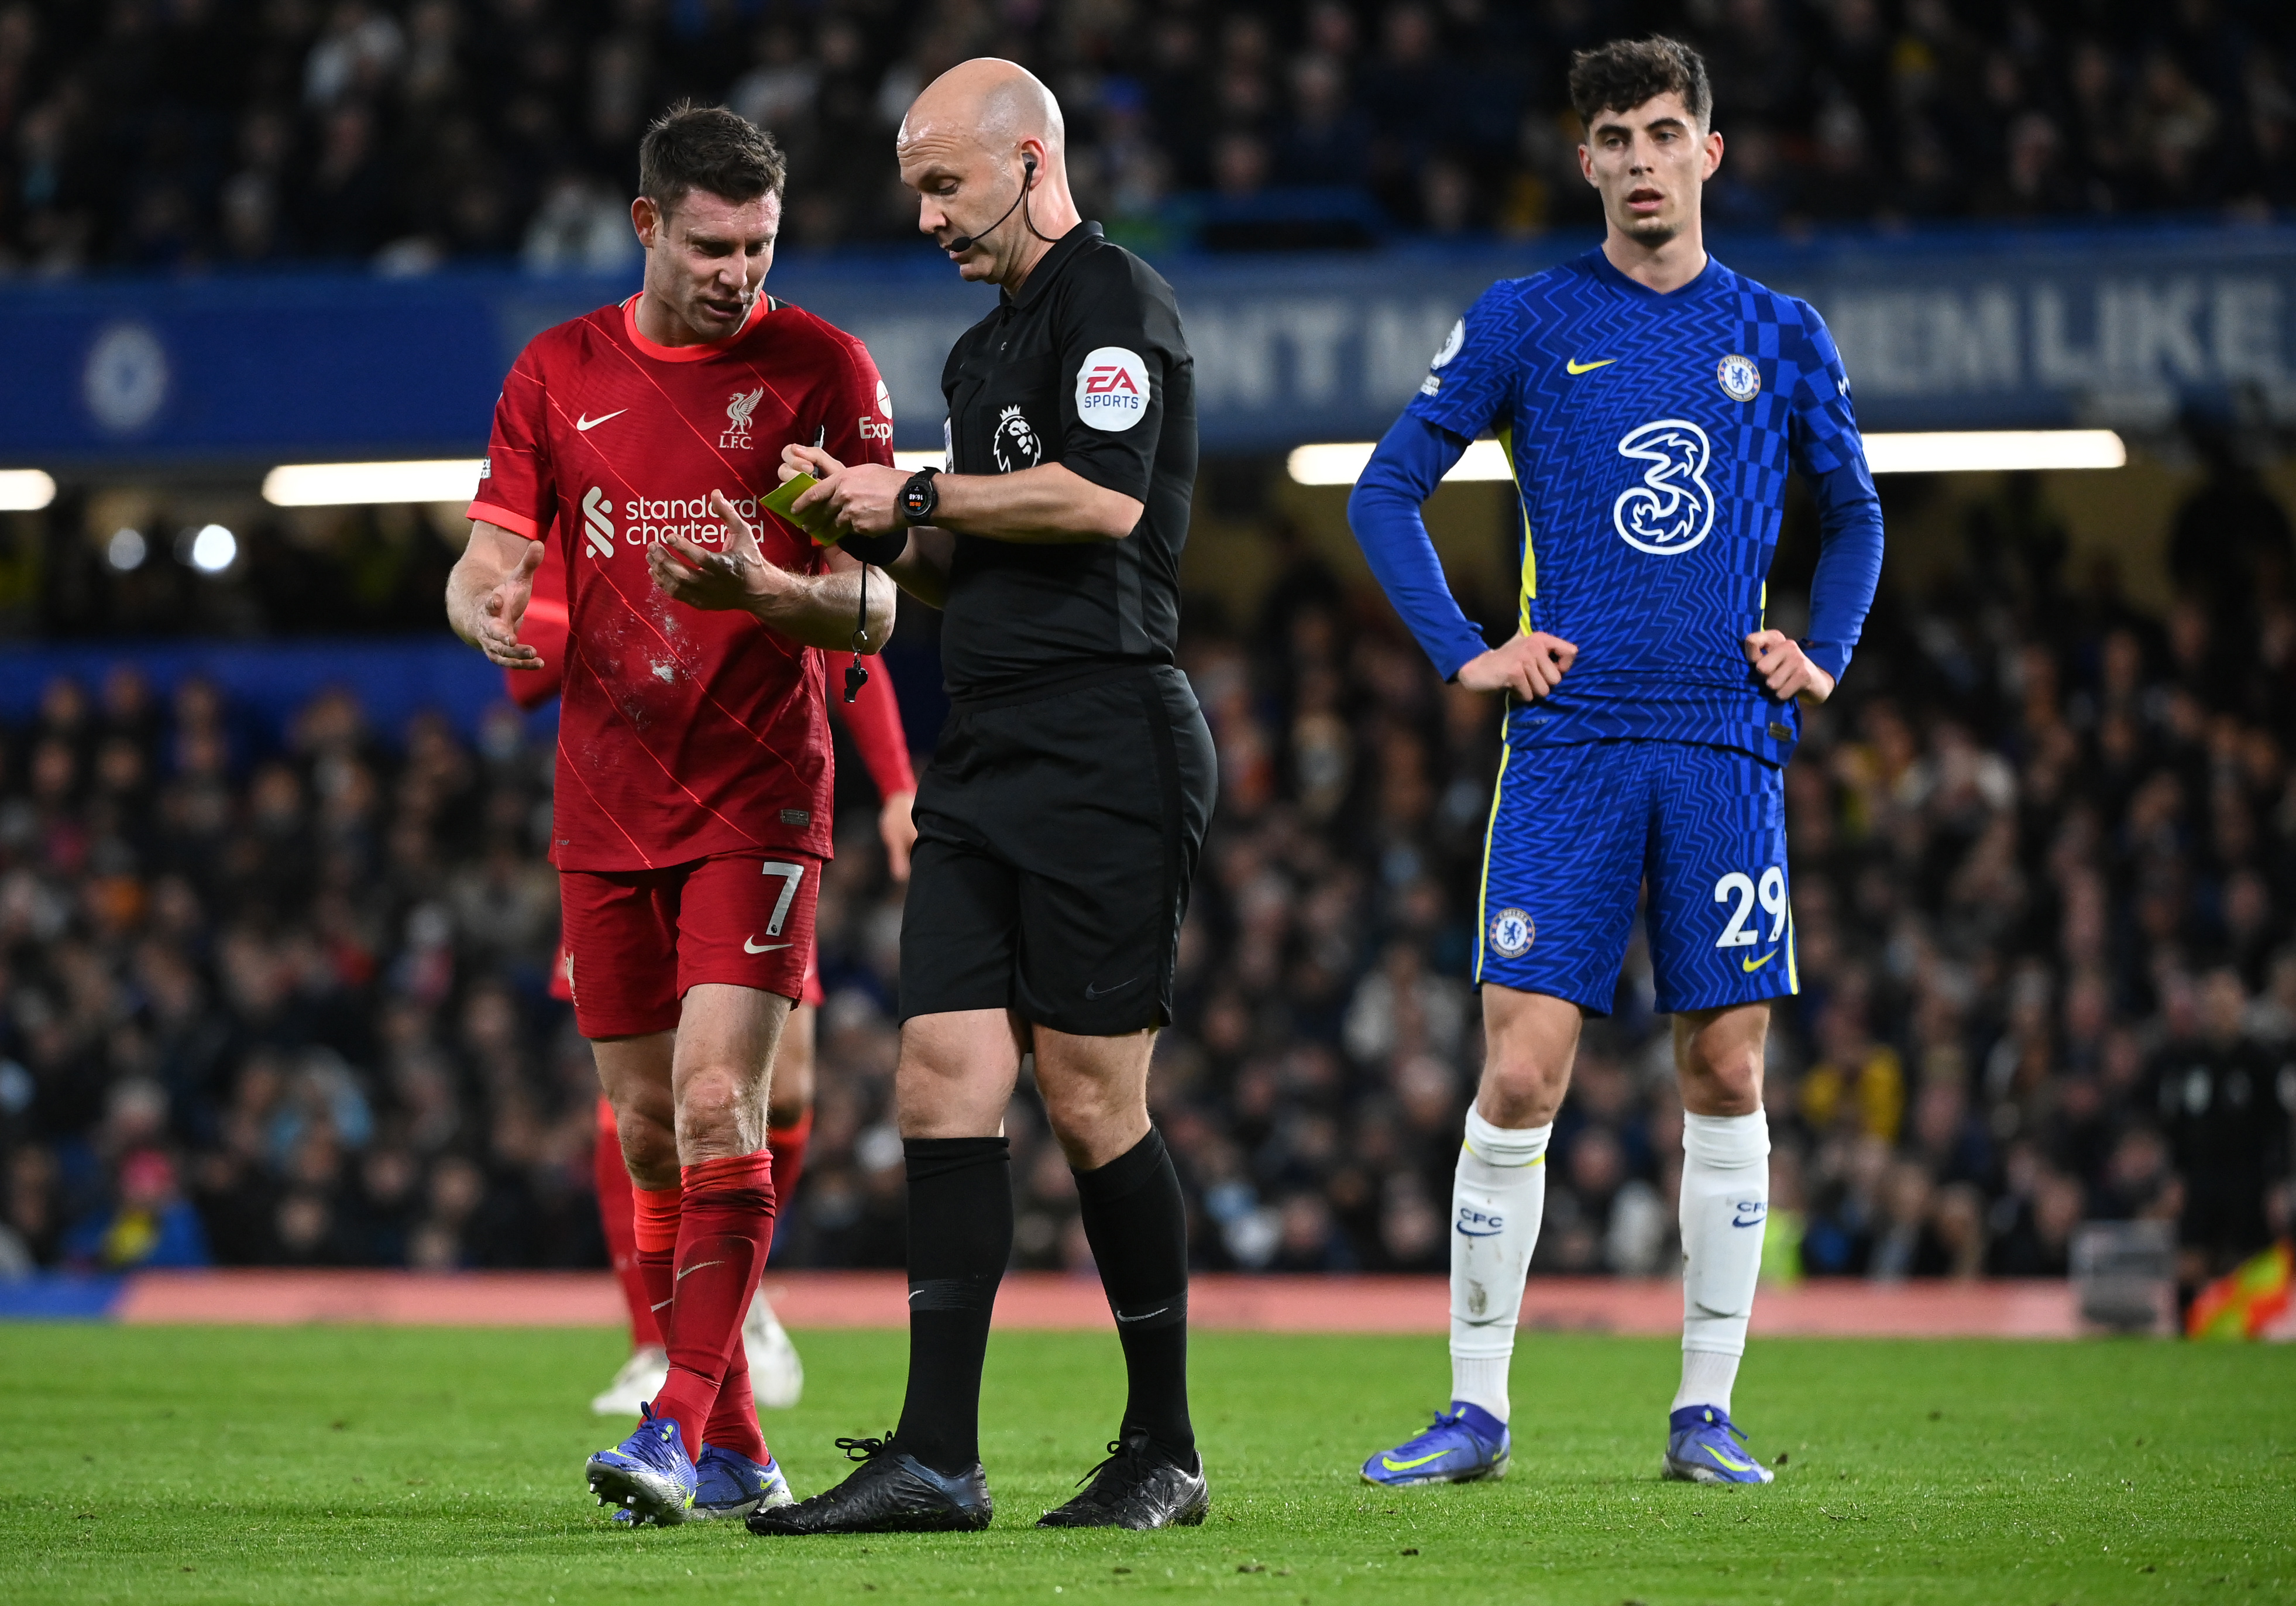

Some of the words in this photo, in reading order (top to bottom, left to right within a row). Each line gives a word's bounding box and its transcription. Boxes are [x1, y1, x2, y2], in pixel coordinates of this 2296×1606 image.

[1086, 366, 1139, 394] EA
[1084, 394, 1139, 409] SPORTS
[719, 435, 754, 450] L.F.C.
[858, 416, 893, 446] Exp
[625, 520, 764, 545] charterd
[762, 862, 804, 936] 7
[1714, 866, 1787, 948] 29
[1460, 1207, 1503, 1228] CFC
